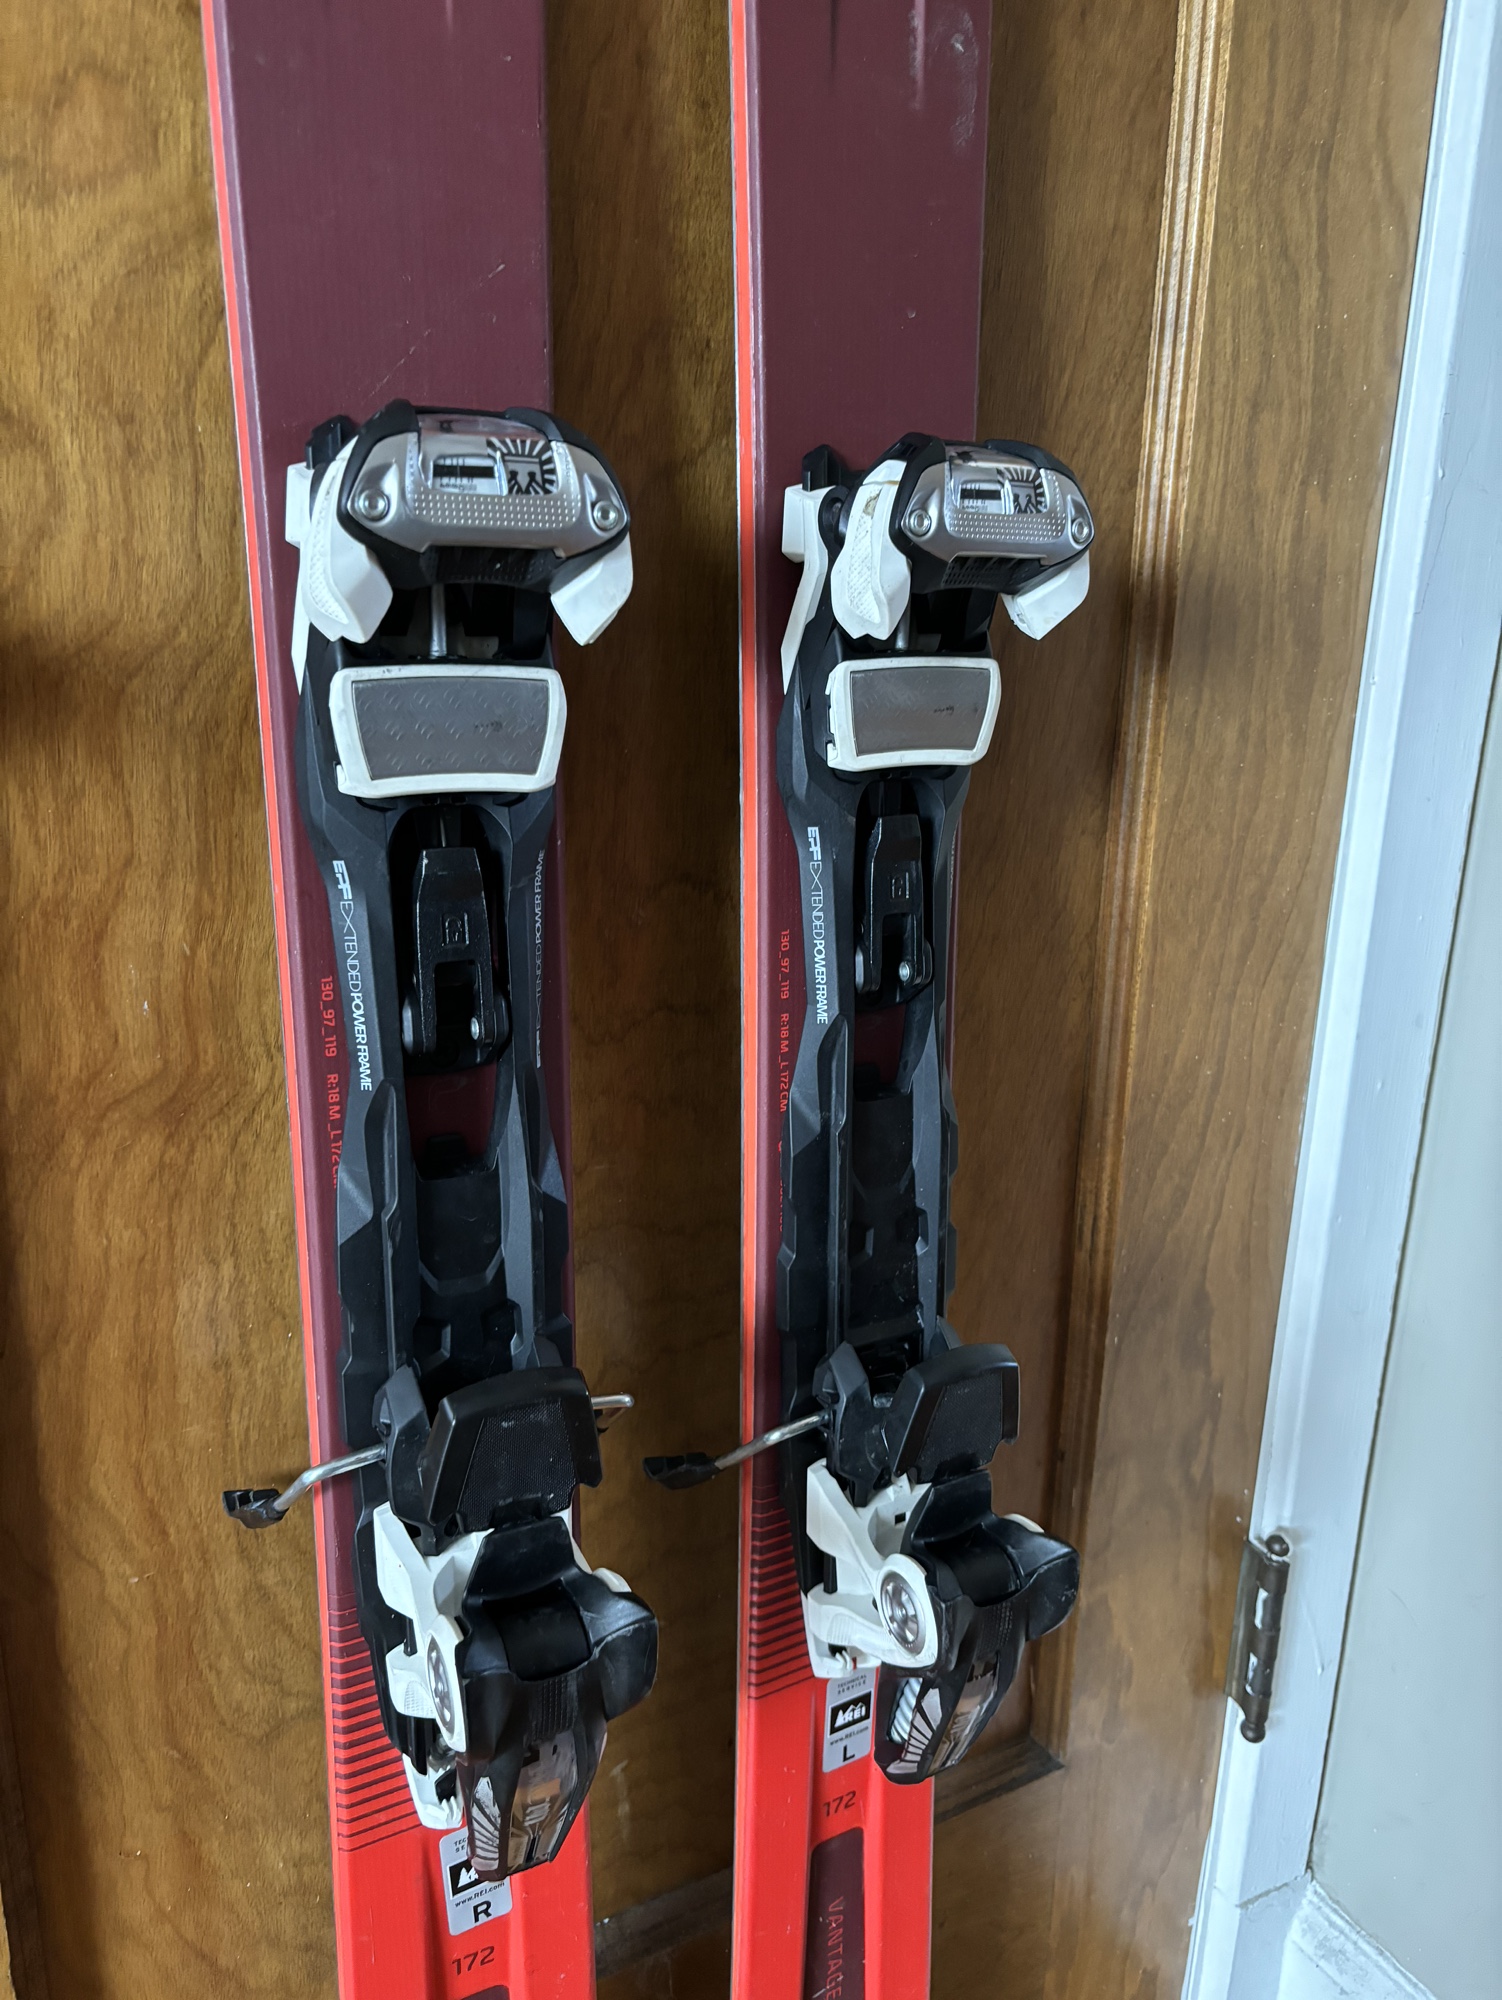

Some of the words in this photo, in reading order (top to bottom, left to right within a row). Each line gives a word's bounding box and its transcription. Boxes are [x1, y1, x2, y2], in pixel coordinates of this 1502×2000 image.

[807, 826, 821, 861] EPF
[333, 860, 353, 900] EPF
[535, 848, 546, 893] FRAME
[809, 861, 825, 940] EXTENDED
[340, 901, 362, 992] EXTENDED
[813, 940, 827, 984] POWER
[351, 992, 368, 1044] POWER
[815, 985, 829, 1025] FRAME
[357, 1045, 373, 1092] FRAME
[843, 1745, 856, 1763] L
[822, 1790, 857, 1817] 172
[454, 1882, 506, 1908] www.REI.com
[472, 1900, 492, 1924] R
[452, 1945, 495, 1976] 172
[825, 1895, 844, 2000] VANTAGE
